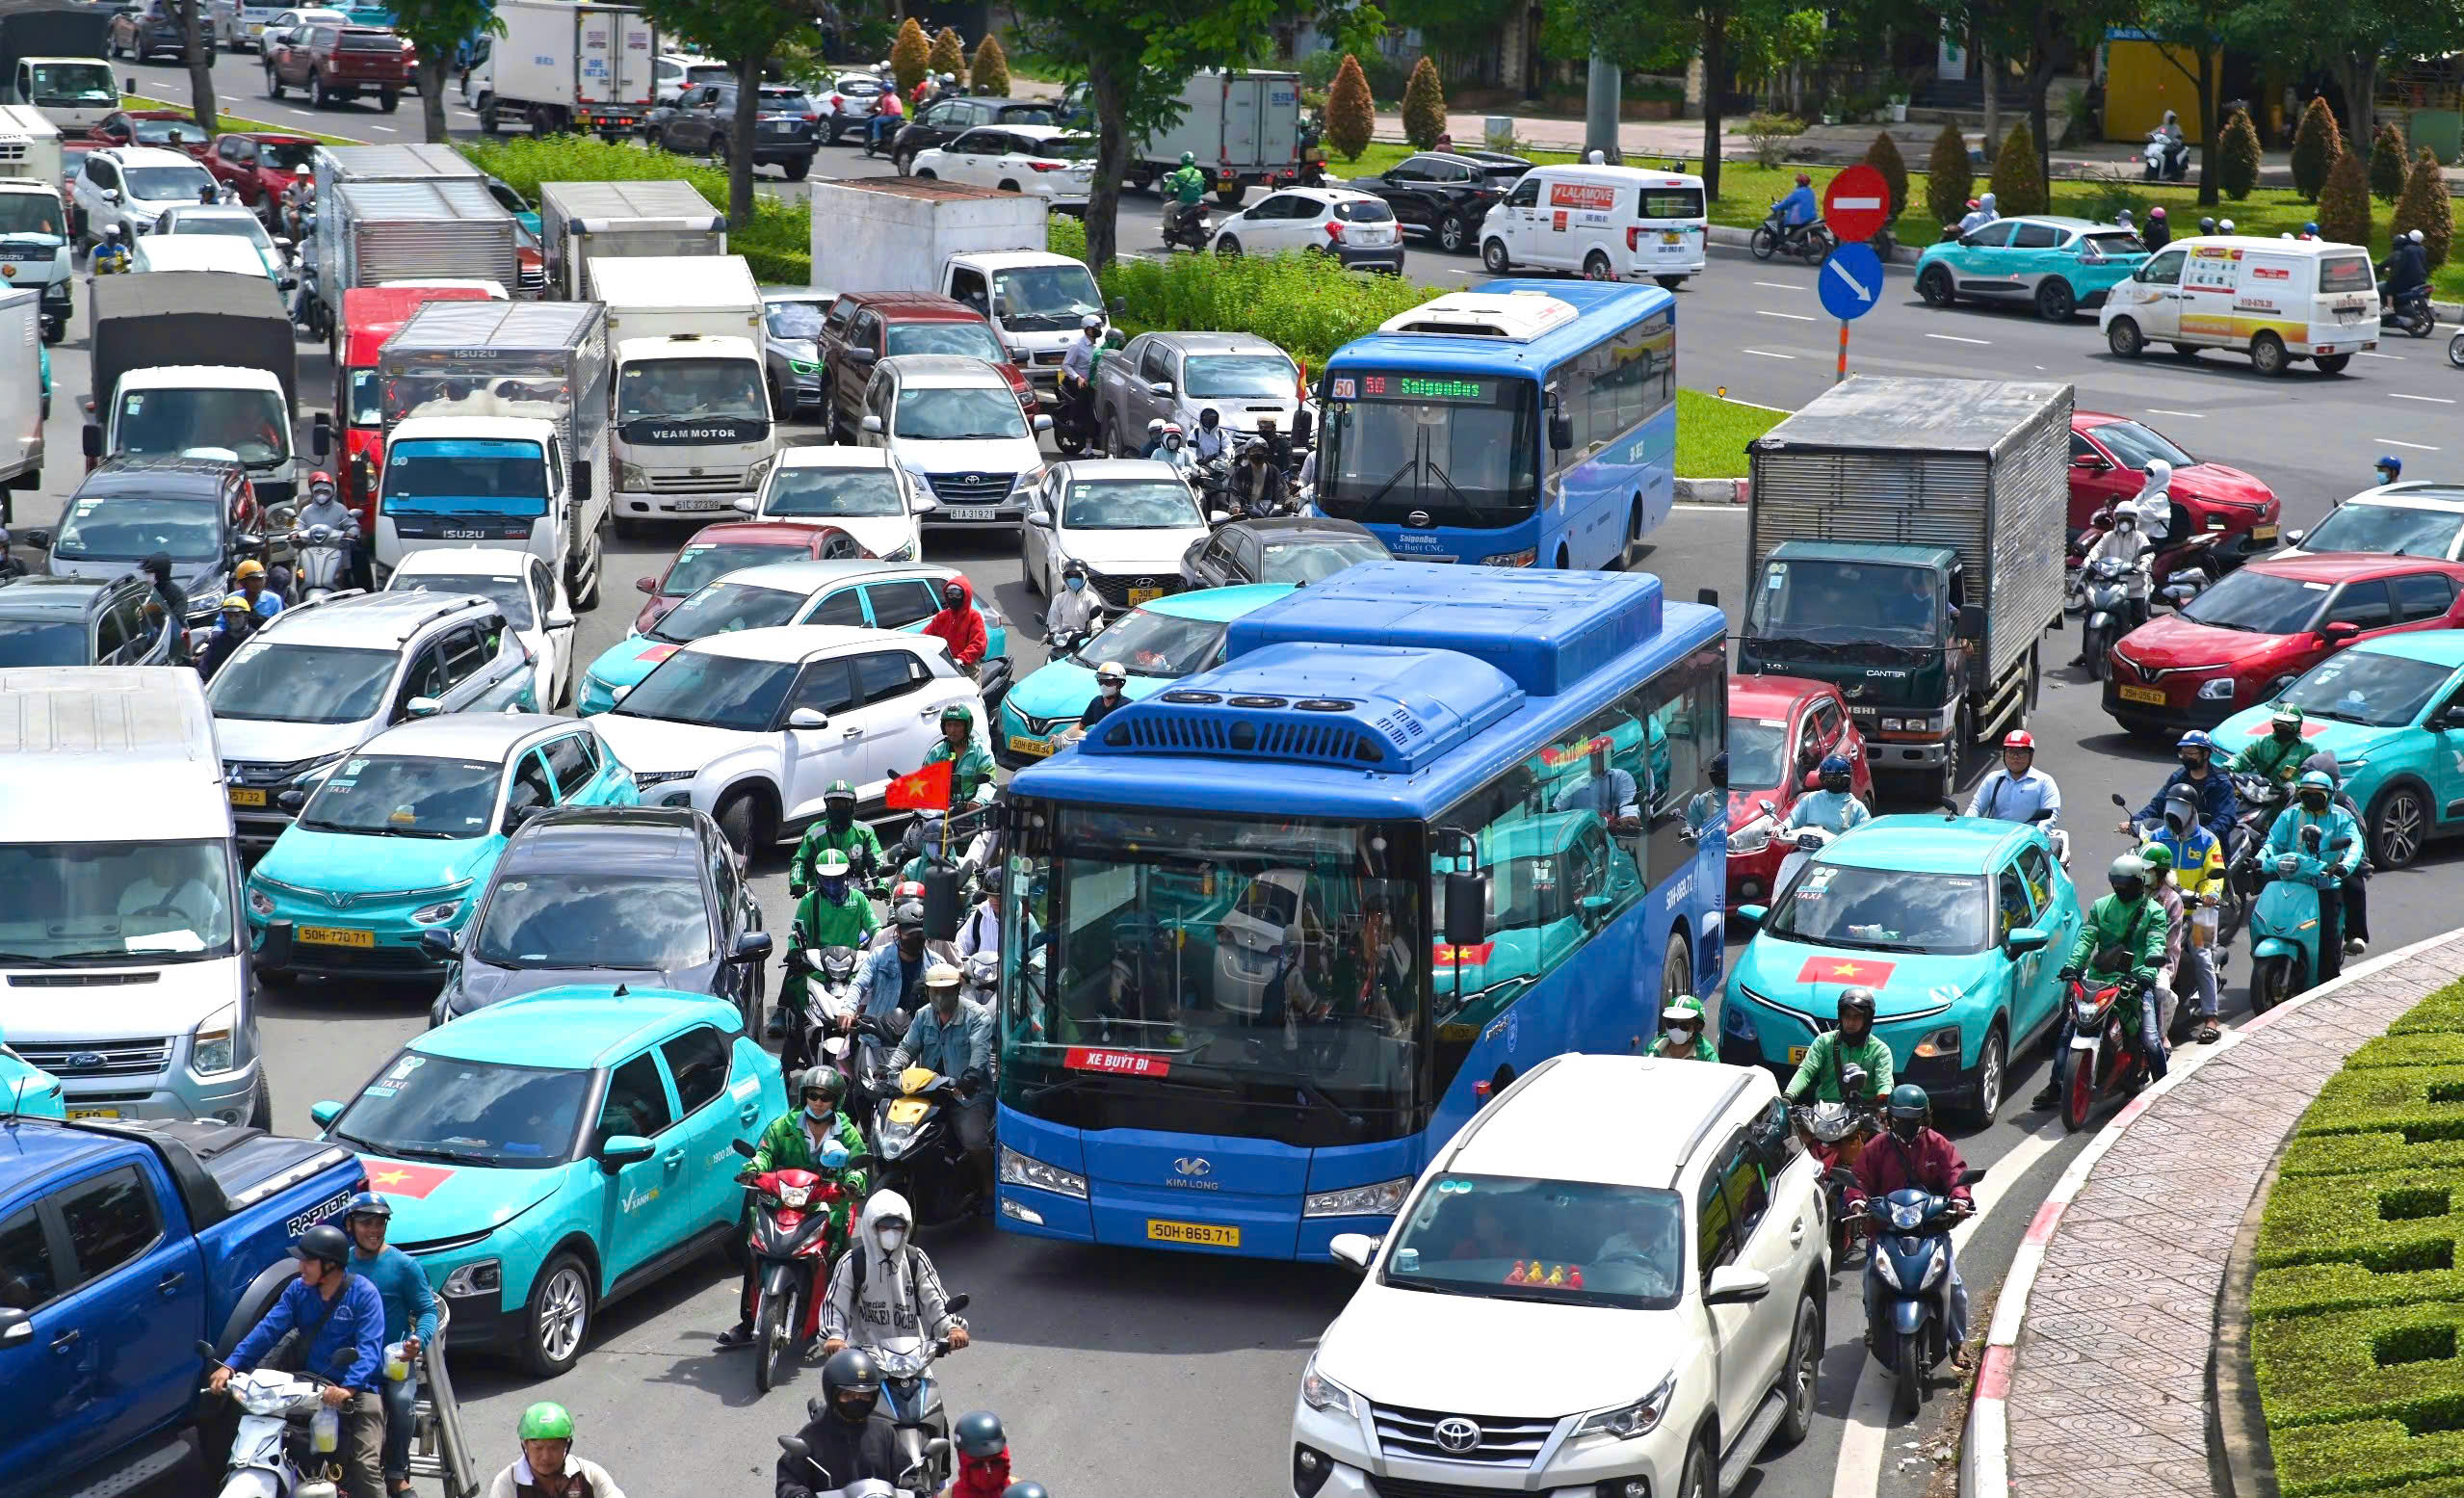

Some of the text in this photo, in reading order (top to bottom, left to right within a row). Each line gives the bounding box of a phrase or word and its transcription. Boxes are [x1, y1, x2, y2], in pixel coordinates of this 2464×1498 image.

[1562, 188, 1613, 201] LALAMOVE
[455, 350, 497, 358] ISUZU
[1334, 380, 1353, 397] 50
[1366, 377, 1480, 397] 50 SaigonBus
[653, 430, 688, 438] VEAM
[443, 530, 485, 539] ISUZU
[1400, 534, 1438, 543] SaigonBus
[1404, 543, 1424, 552] Buýt
[1866, 670, 1906, 678] CANTER
[2188, 846, 2202, 860] be
[1086, 1052, 1149, 1070] XE BUÝT ĐI
[380, 1080, 407, 1090] TAXI
[1166, 1178, 1219, 1191] KIM LONG
[287, 1190, 351, 1237] RAPTOR
[1155, 1223, 1231, 1243] 50H-869.71
